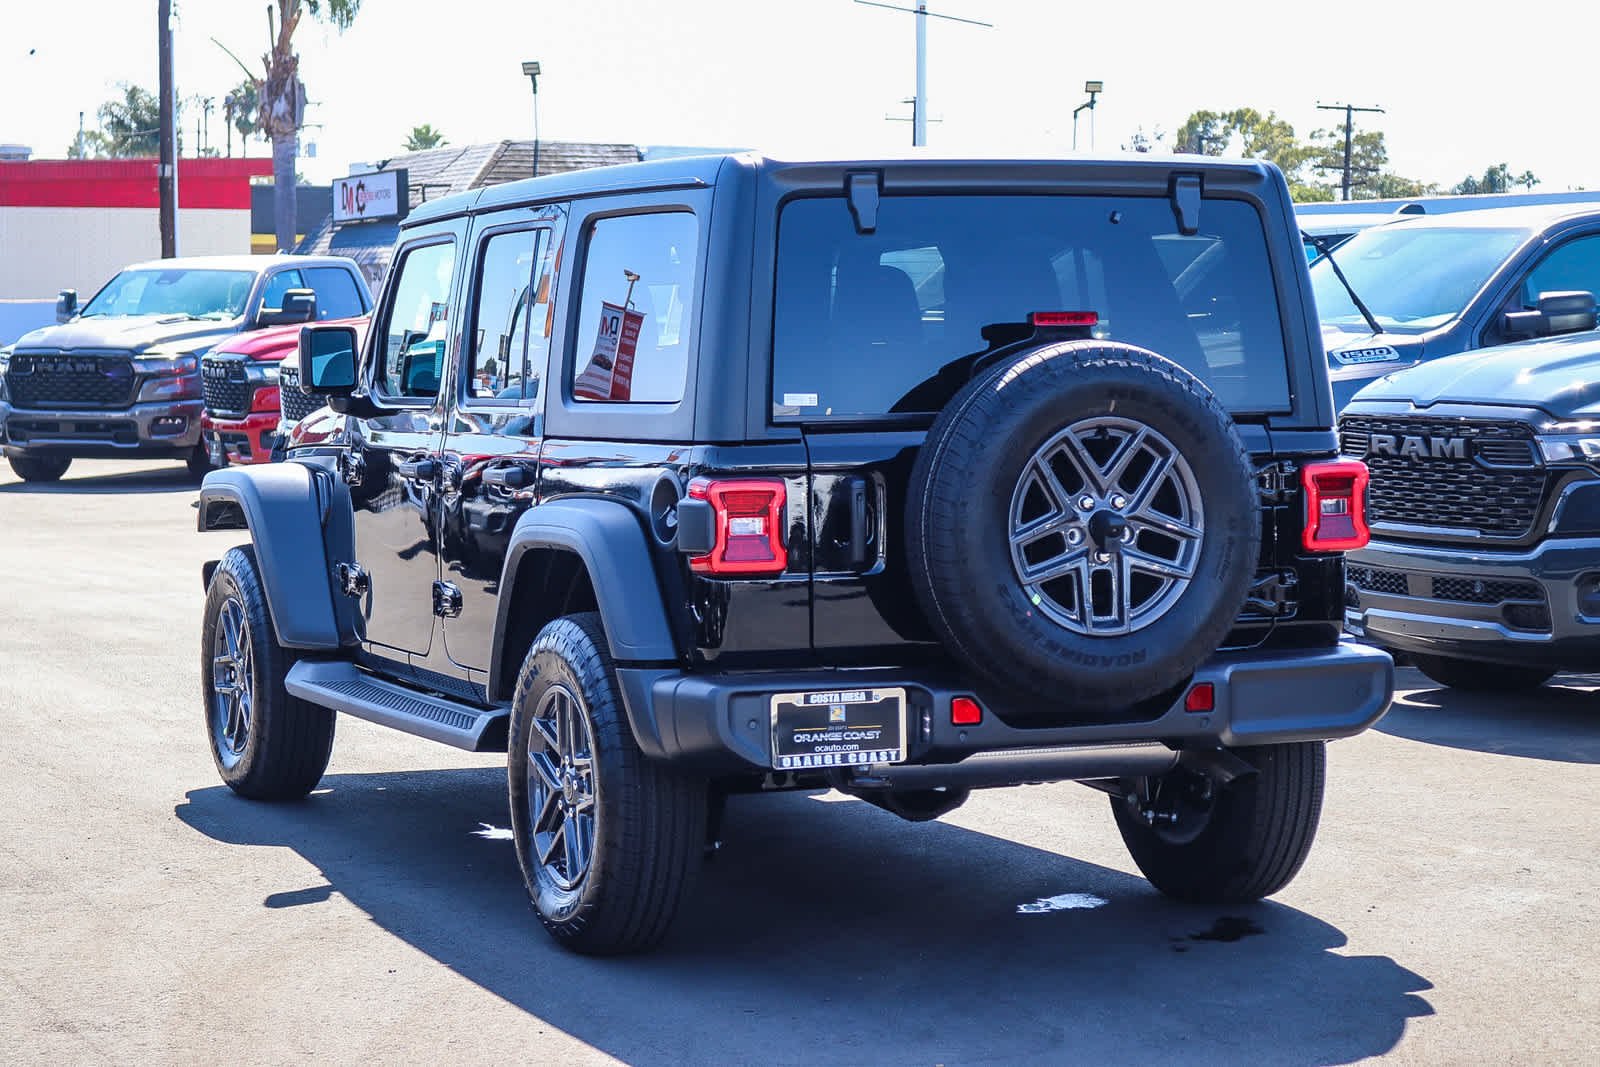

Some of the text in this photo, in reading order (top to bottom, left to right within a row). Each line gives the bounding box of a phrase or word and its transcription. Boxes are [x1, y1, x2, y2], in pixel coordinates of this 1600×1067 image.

[1343, 349, 1388, 358] 1500
[37, 362, 96, 373] RAM
[1370, 434, 1466, 458] RAM
[810, 692, 866, 704] COSTA MESA
[793, 730, 881, 743] ORANGE COAST
[814, 744, 860, 752] ocauto.com
[782, 751, 898, 768] ORANGE COAST
